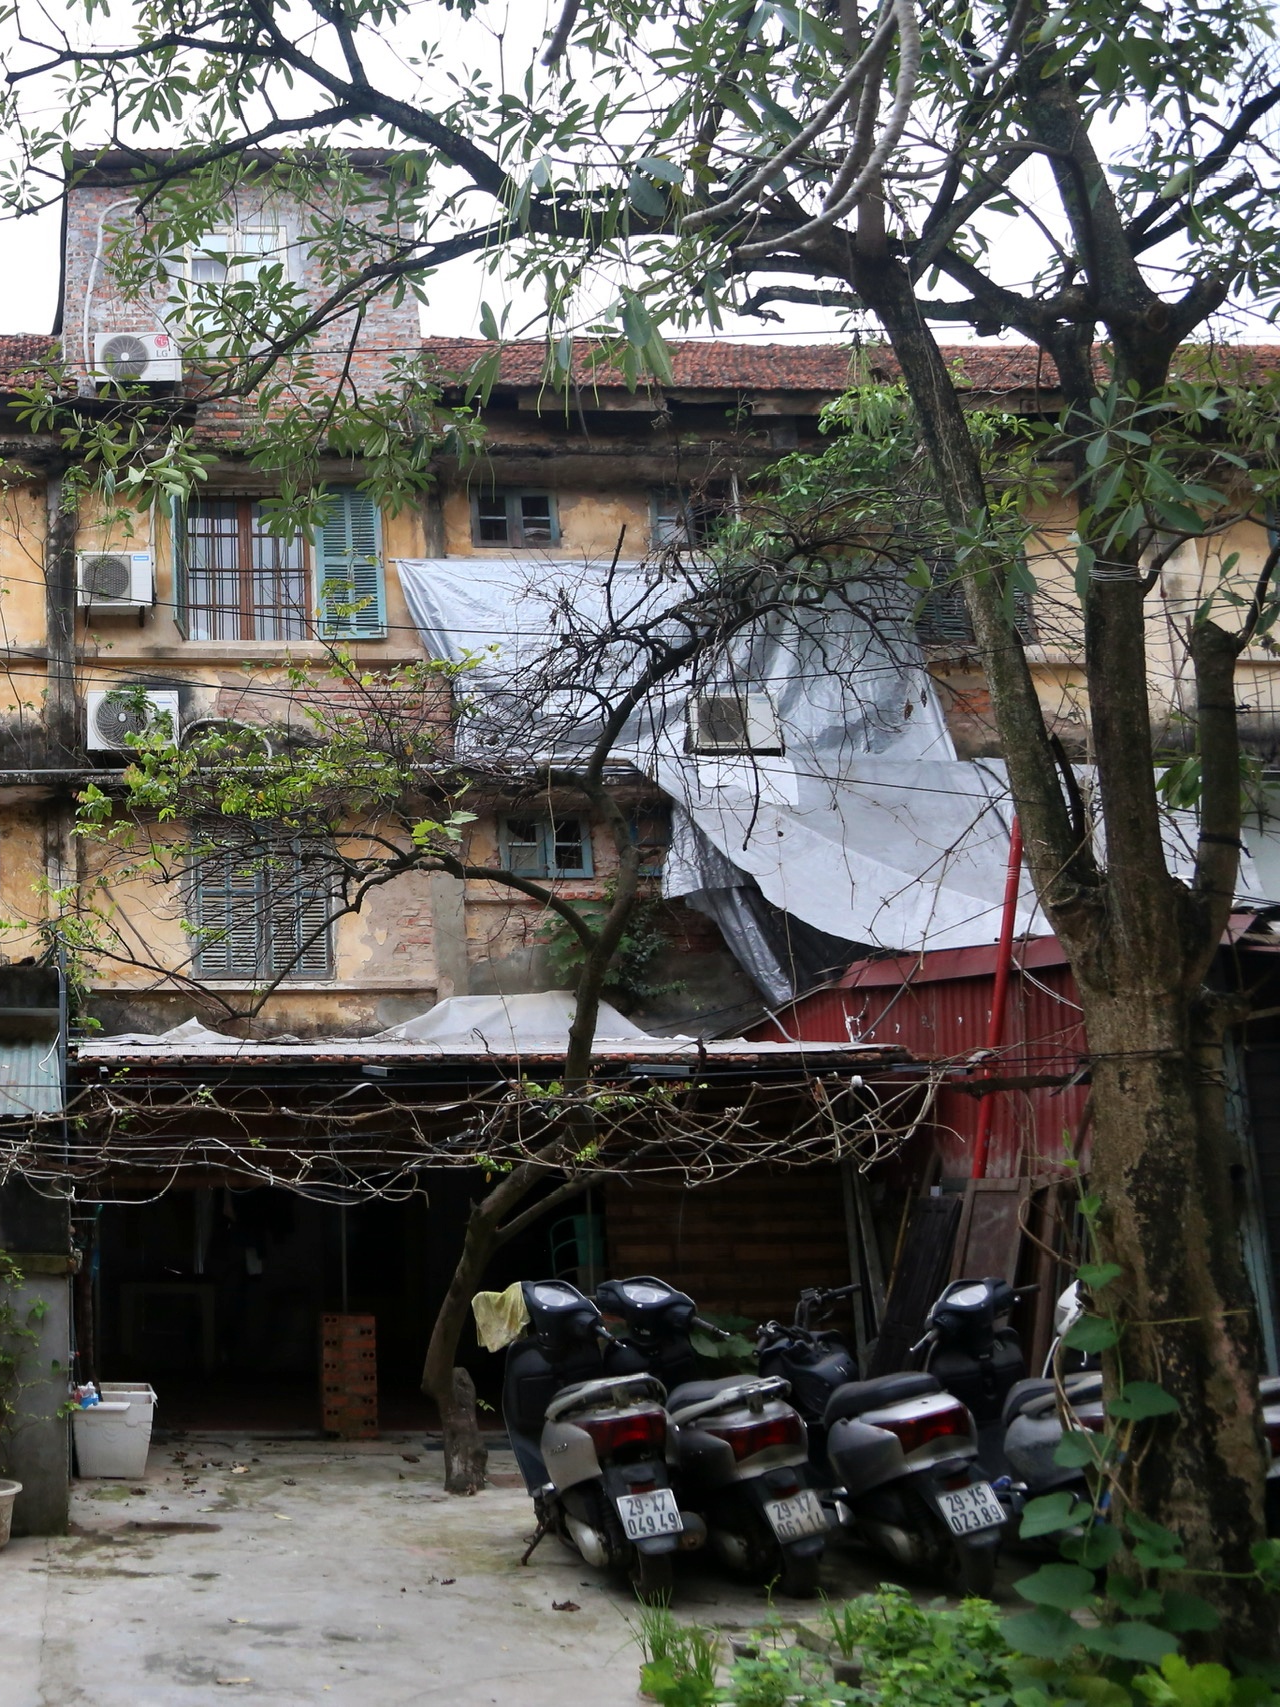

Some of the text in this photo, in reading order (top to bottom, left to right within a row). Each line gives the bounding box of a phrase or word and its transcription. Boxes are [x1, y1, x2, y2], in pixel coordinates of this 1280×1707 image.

[156, 350, 168, 358] LG
[626, 1492, 665, 1516] 29-X7
[945, 1486, 988, 1513] 29-X5
[628, 1512, 678, 1535] 049.49
[951, 1504, 1002, 1532] 023.89
